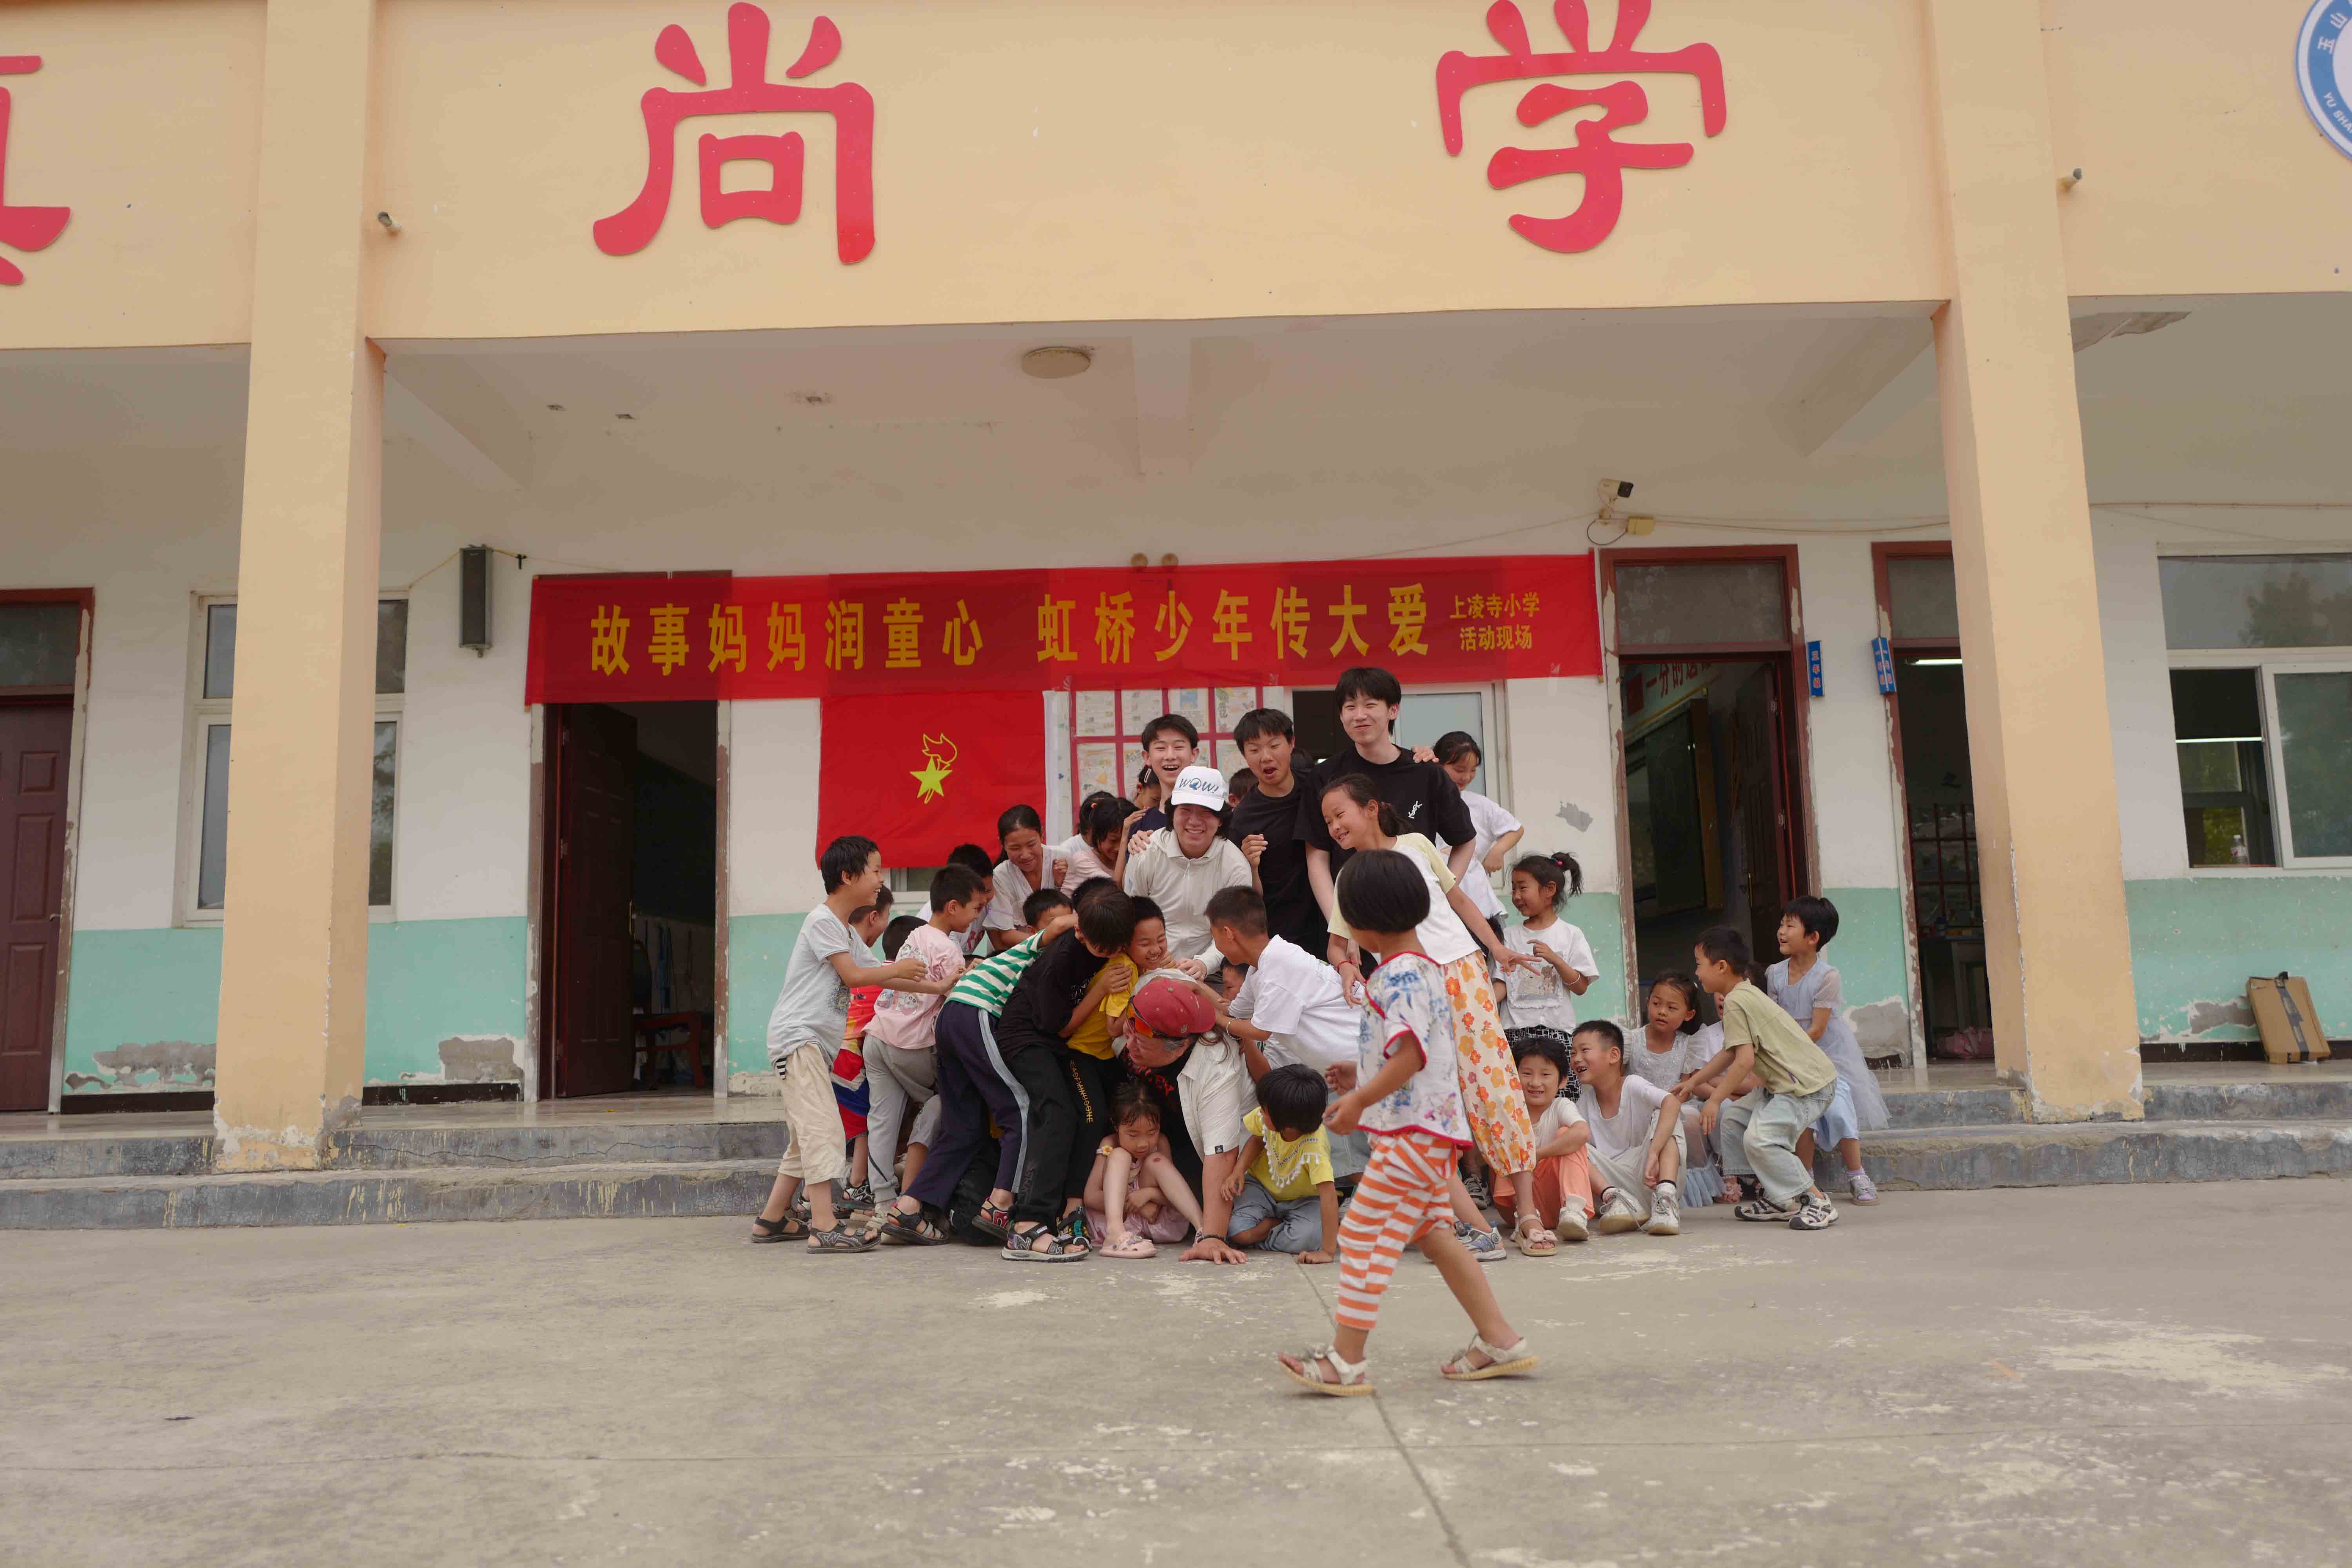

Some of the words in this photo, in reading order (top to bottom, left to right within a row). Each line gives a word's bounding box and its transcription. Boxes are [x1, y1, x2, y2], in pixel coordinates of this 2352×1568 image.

[593, 2, 875, 265] 尚
[1436, 0, 1726, 253] 学
[2333, 110, 2352, 134] SHA
[590, 597, 984, 676] 故事妈妈润童心
[1037, 583, 1428, 664] 虹桥少年传大爱
[1460, 624, 1532, 651] 活动现场
